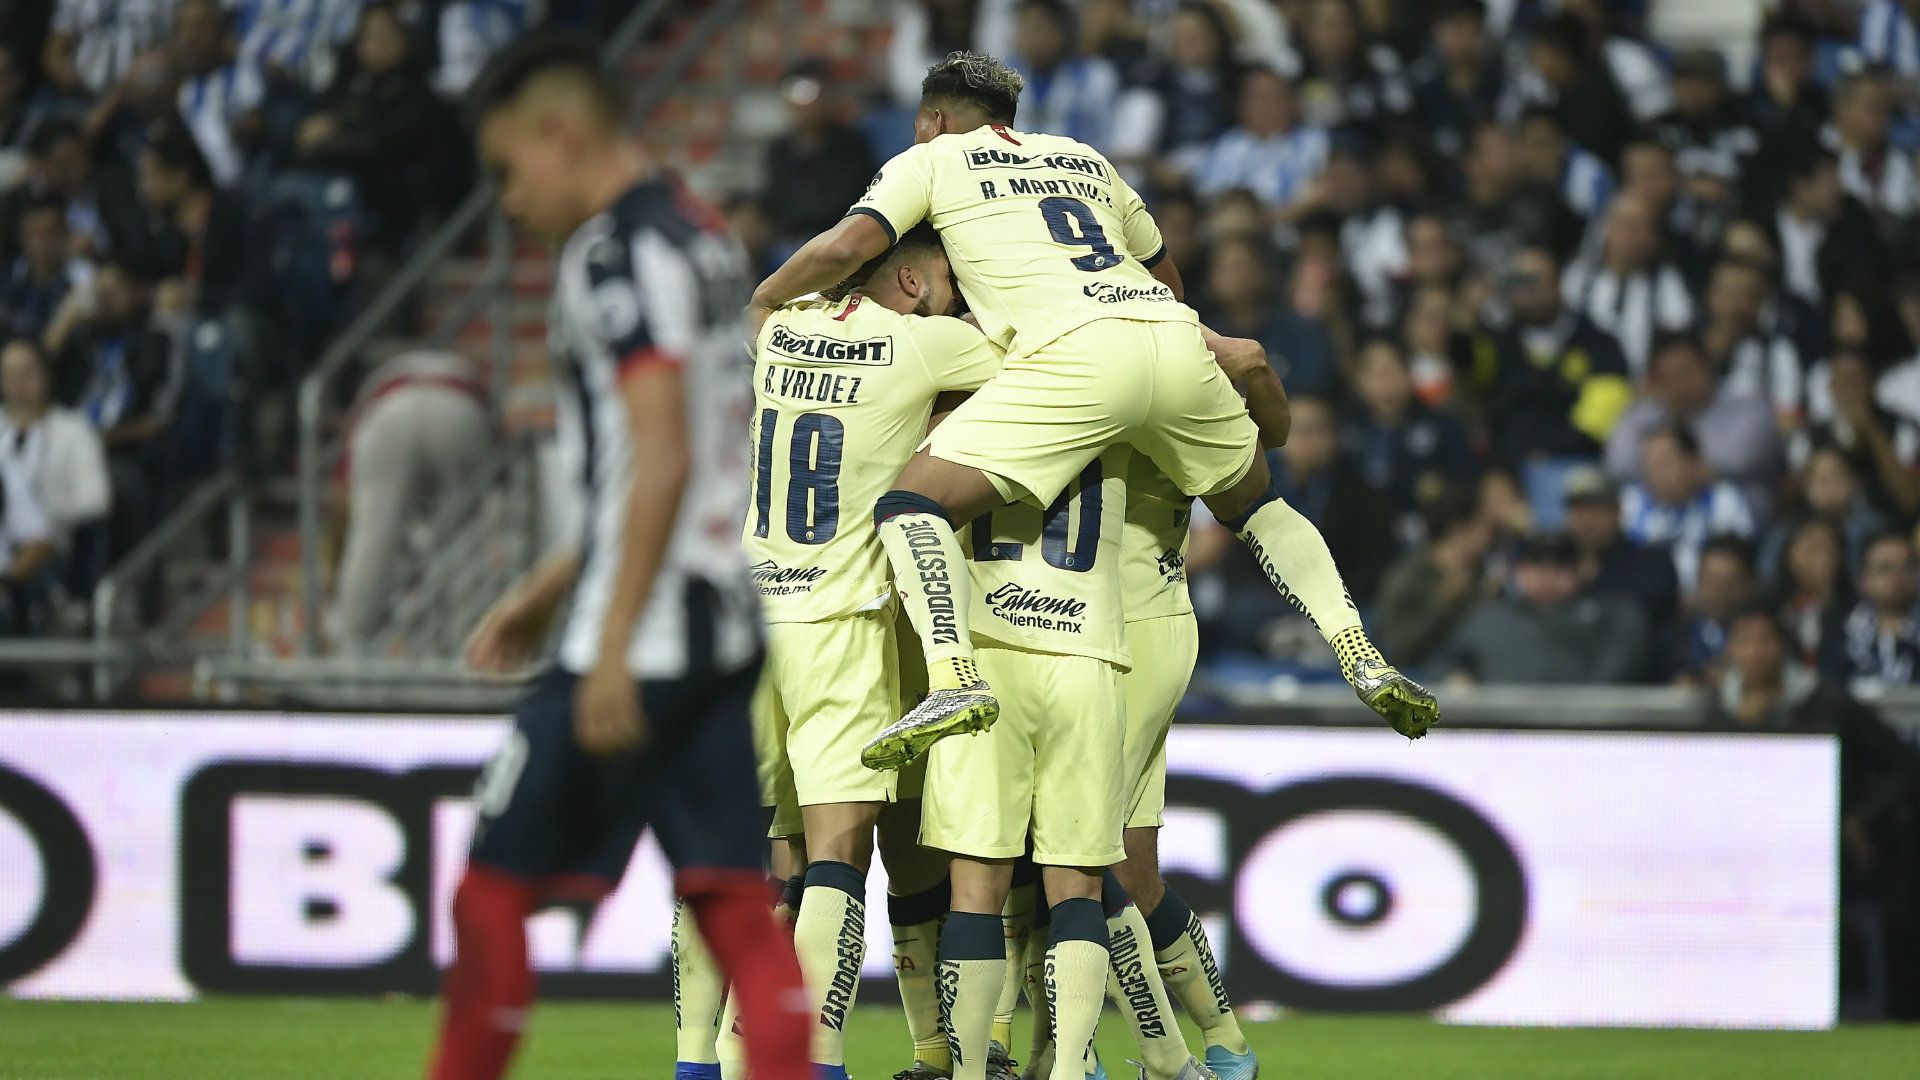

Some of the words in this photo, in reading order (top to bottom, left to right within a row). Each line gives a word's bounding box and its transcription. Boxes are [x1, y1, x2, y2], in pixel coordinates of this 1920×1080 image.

[980, 180, 1006, 200] R.
[1038, 195, 1125, 273] 9
[780, 368, 862, 404] VALDEZ
[753, 408, 845, 545] 18
[899, 520, 960, 645] BRIDGESTONE
[985, 581, 1087, 618] Caliente
[819, 895, 866, 1032] BRIDGESTONE
[1109, 924, 1167, 1040] BRIDGESTONE
